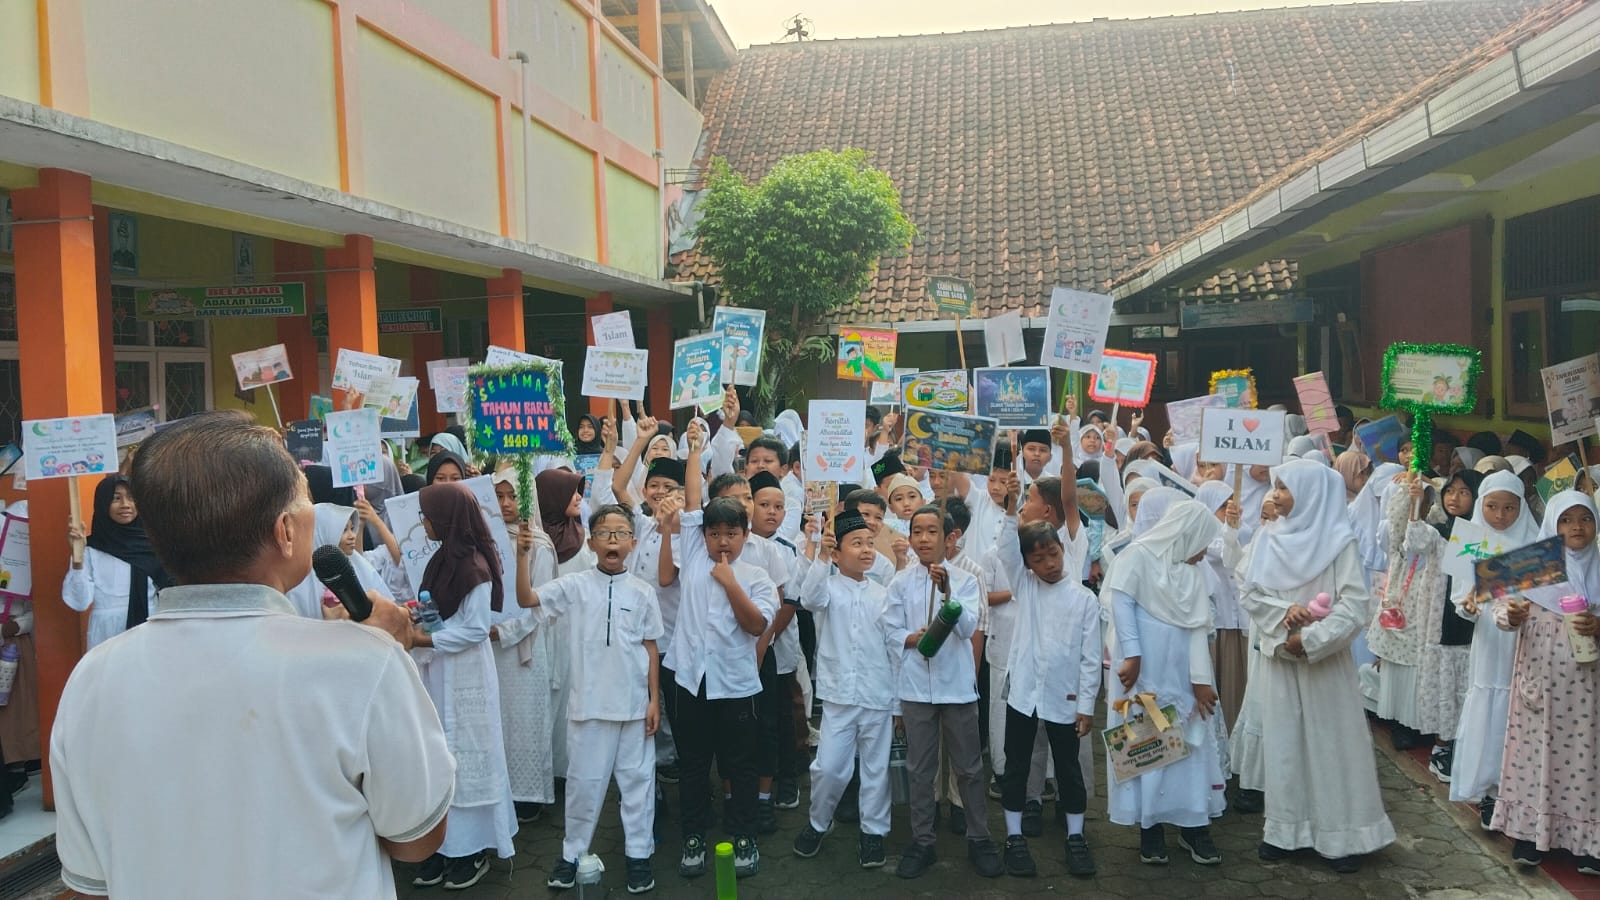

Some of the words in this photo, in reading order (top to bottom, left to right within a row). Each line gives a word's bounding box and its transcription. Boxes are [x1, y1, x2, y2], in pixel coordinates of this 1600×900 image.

[207, 286, 281, 296] BELAJAR
[204, 299, 246, 307] ADALAH
[196, 309, 217, 317] DAN
[602, 330, 628, 341] Islam
[480, 373, 550, 402] SELAMA
[481, 402, 521, 416] TAHUN
[524, 401, 553, 415] BARU
[496, 416, 549, 430] ISLAM
[1228, 418, 1234, 431] I
[503, 434, 529, 448] 1448
[1214, 436, 1271, 451] ISLAM
